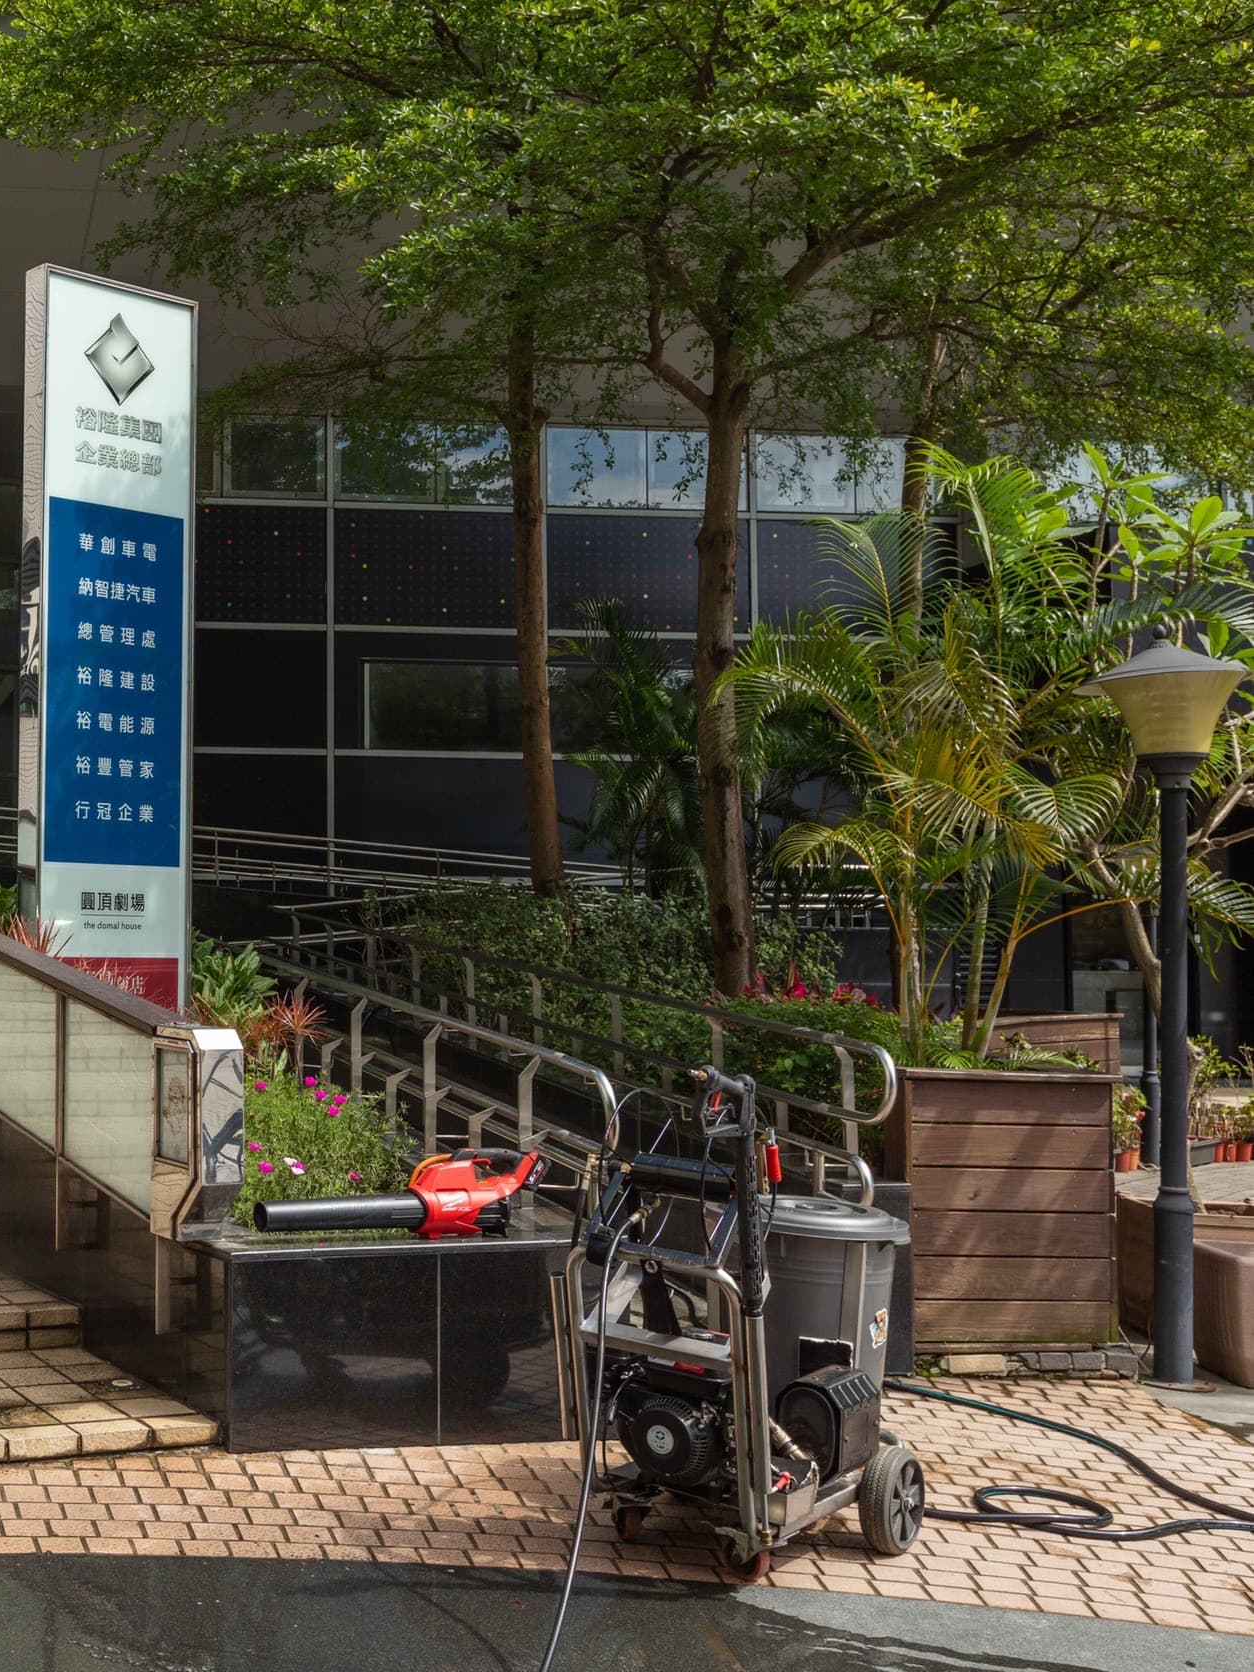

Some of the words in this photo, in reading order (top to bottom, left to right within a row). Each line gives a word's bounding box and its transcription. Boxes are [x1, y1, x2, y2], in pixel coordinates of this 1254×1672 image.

[75, 406, 163, 444] 裕隆集團
[75, 441, 162, 477] 企業總部
[79, 532, 157, 562] 華創車電
[78, 577, 156, 605] 納智捷汽車
[77, 621, 156, 649] 總管理處
[76, 665, 155, 692] 裕隆建設
[76, 710, 155, 736] 裕電能源
[75, 755, 154, 779] 裕豐管家
[74, 800, 154, 823] 行冠企業
[81, 891, 145, 912] 圓頂劇場
[83, 920, 96, 930] the
[97, 920, 120, 930] domal
[121, 921, 142, 930] house
